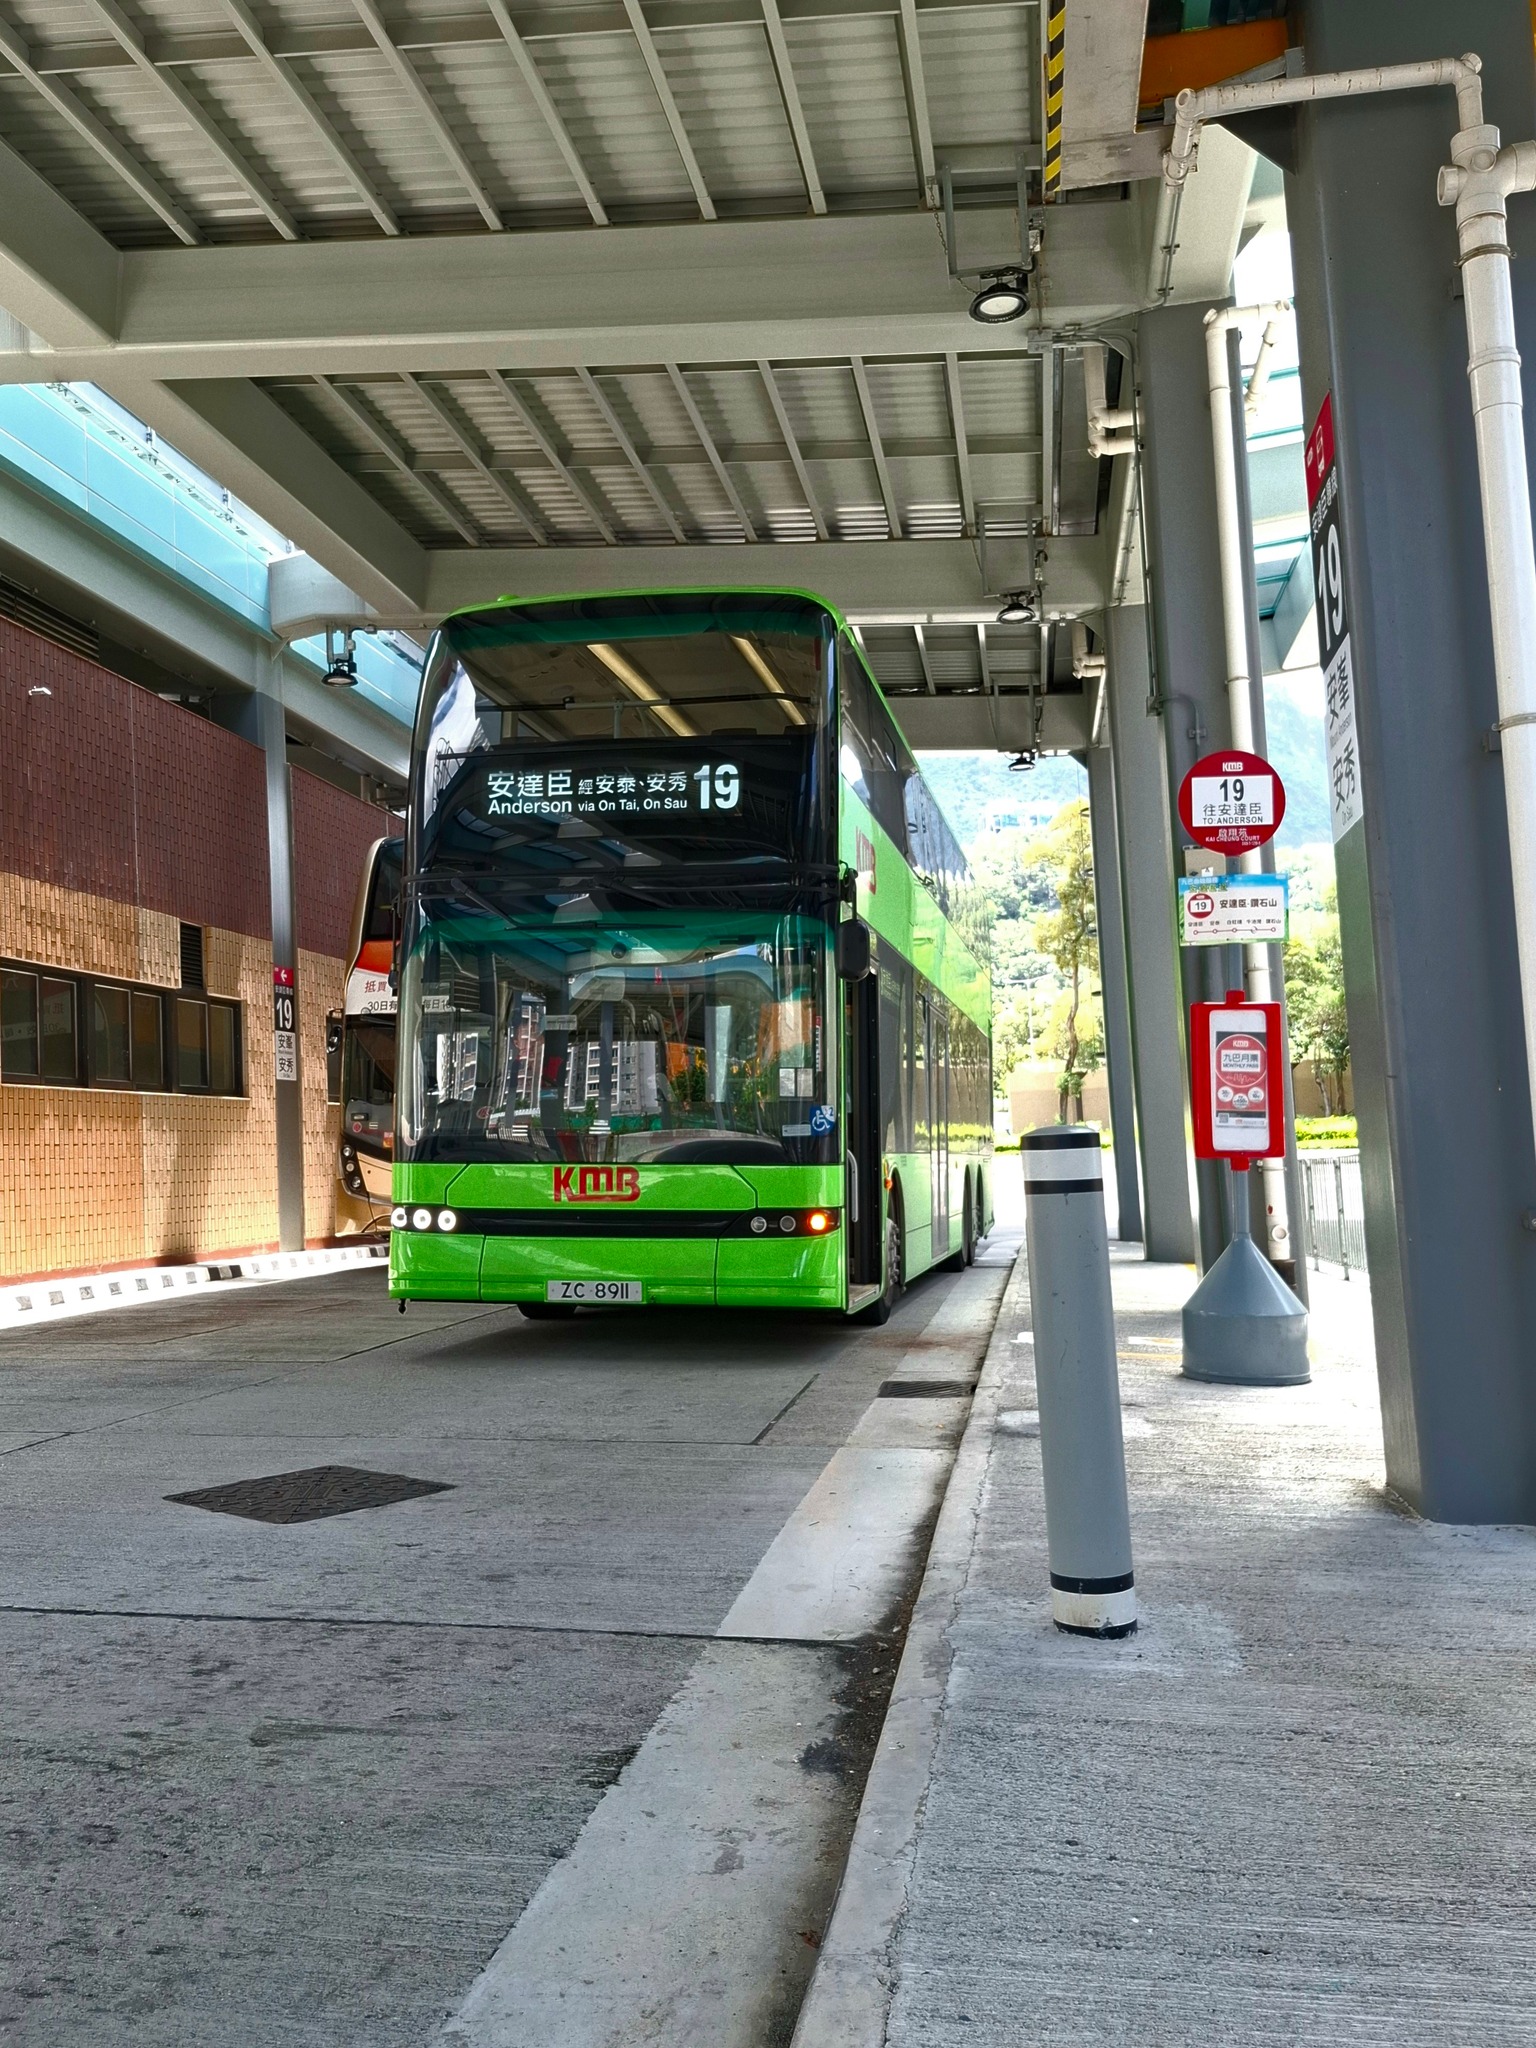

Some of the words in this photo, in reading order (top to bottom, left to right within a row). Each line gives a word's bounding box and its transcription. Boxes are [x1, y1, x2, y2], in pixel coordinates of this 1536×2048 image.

[1318, 524, 1343, 651] 19
[1222, 762, 1243, 772] KMB
[1332, 737, 1355, 813] 安秀
[487, 769, 573, 799] 安達臣
[693, 764, 740, 810] 19
[1219, 778, 1245, 802] 19
[487, 797, 573, 816] Anderson
[577, 800, 596, 812] via
[598, 799, 616, 812] On
[619, 798, 641, 813] Tai,
[643, 797, 661, 811] On
[664, 797, 688, 811] Sau
[1203, 802, 1262, 817] 往安達臣
[1216, 816, 1263, 825] ANDERSON
[1195, 902, 1207, 910] 19
[364, 980, 387, 993] 抵買
[276, 998, 292, 1029] 19
[279, 1057, 294, 1073] 安秀
[1223, 1053, 1259, 1062] 九巴月票
[553, 1166, 641, 1202] KMB
[561, 1282, 585, 1298] ZC
[595, 1282, 629, 1299] 8911
